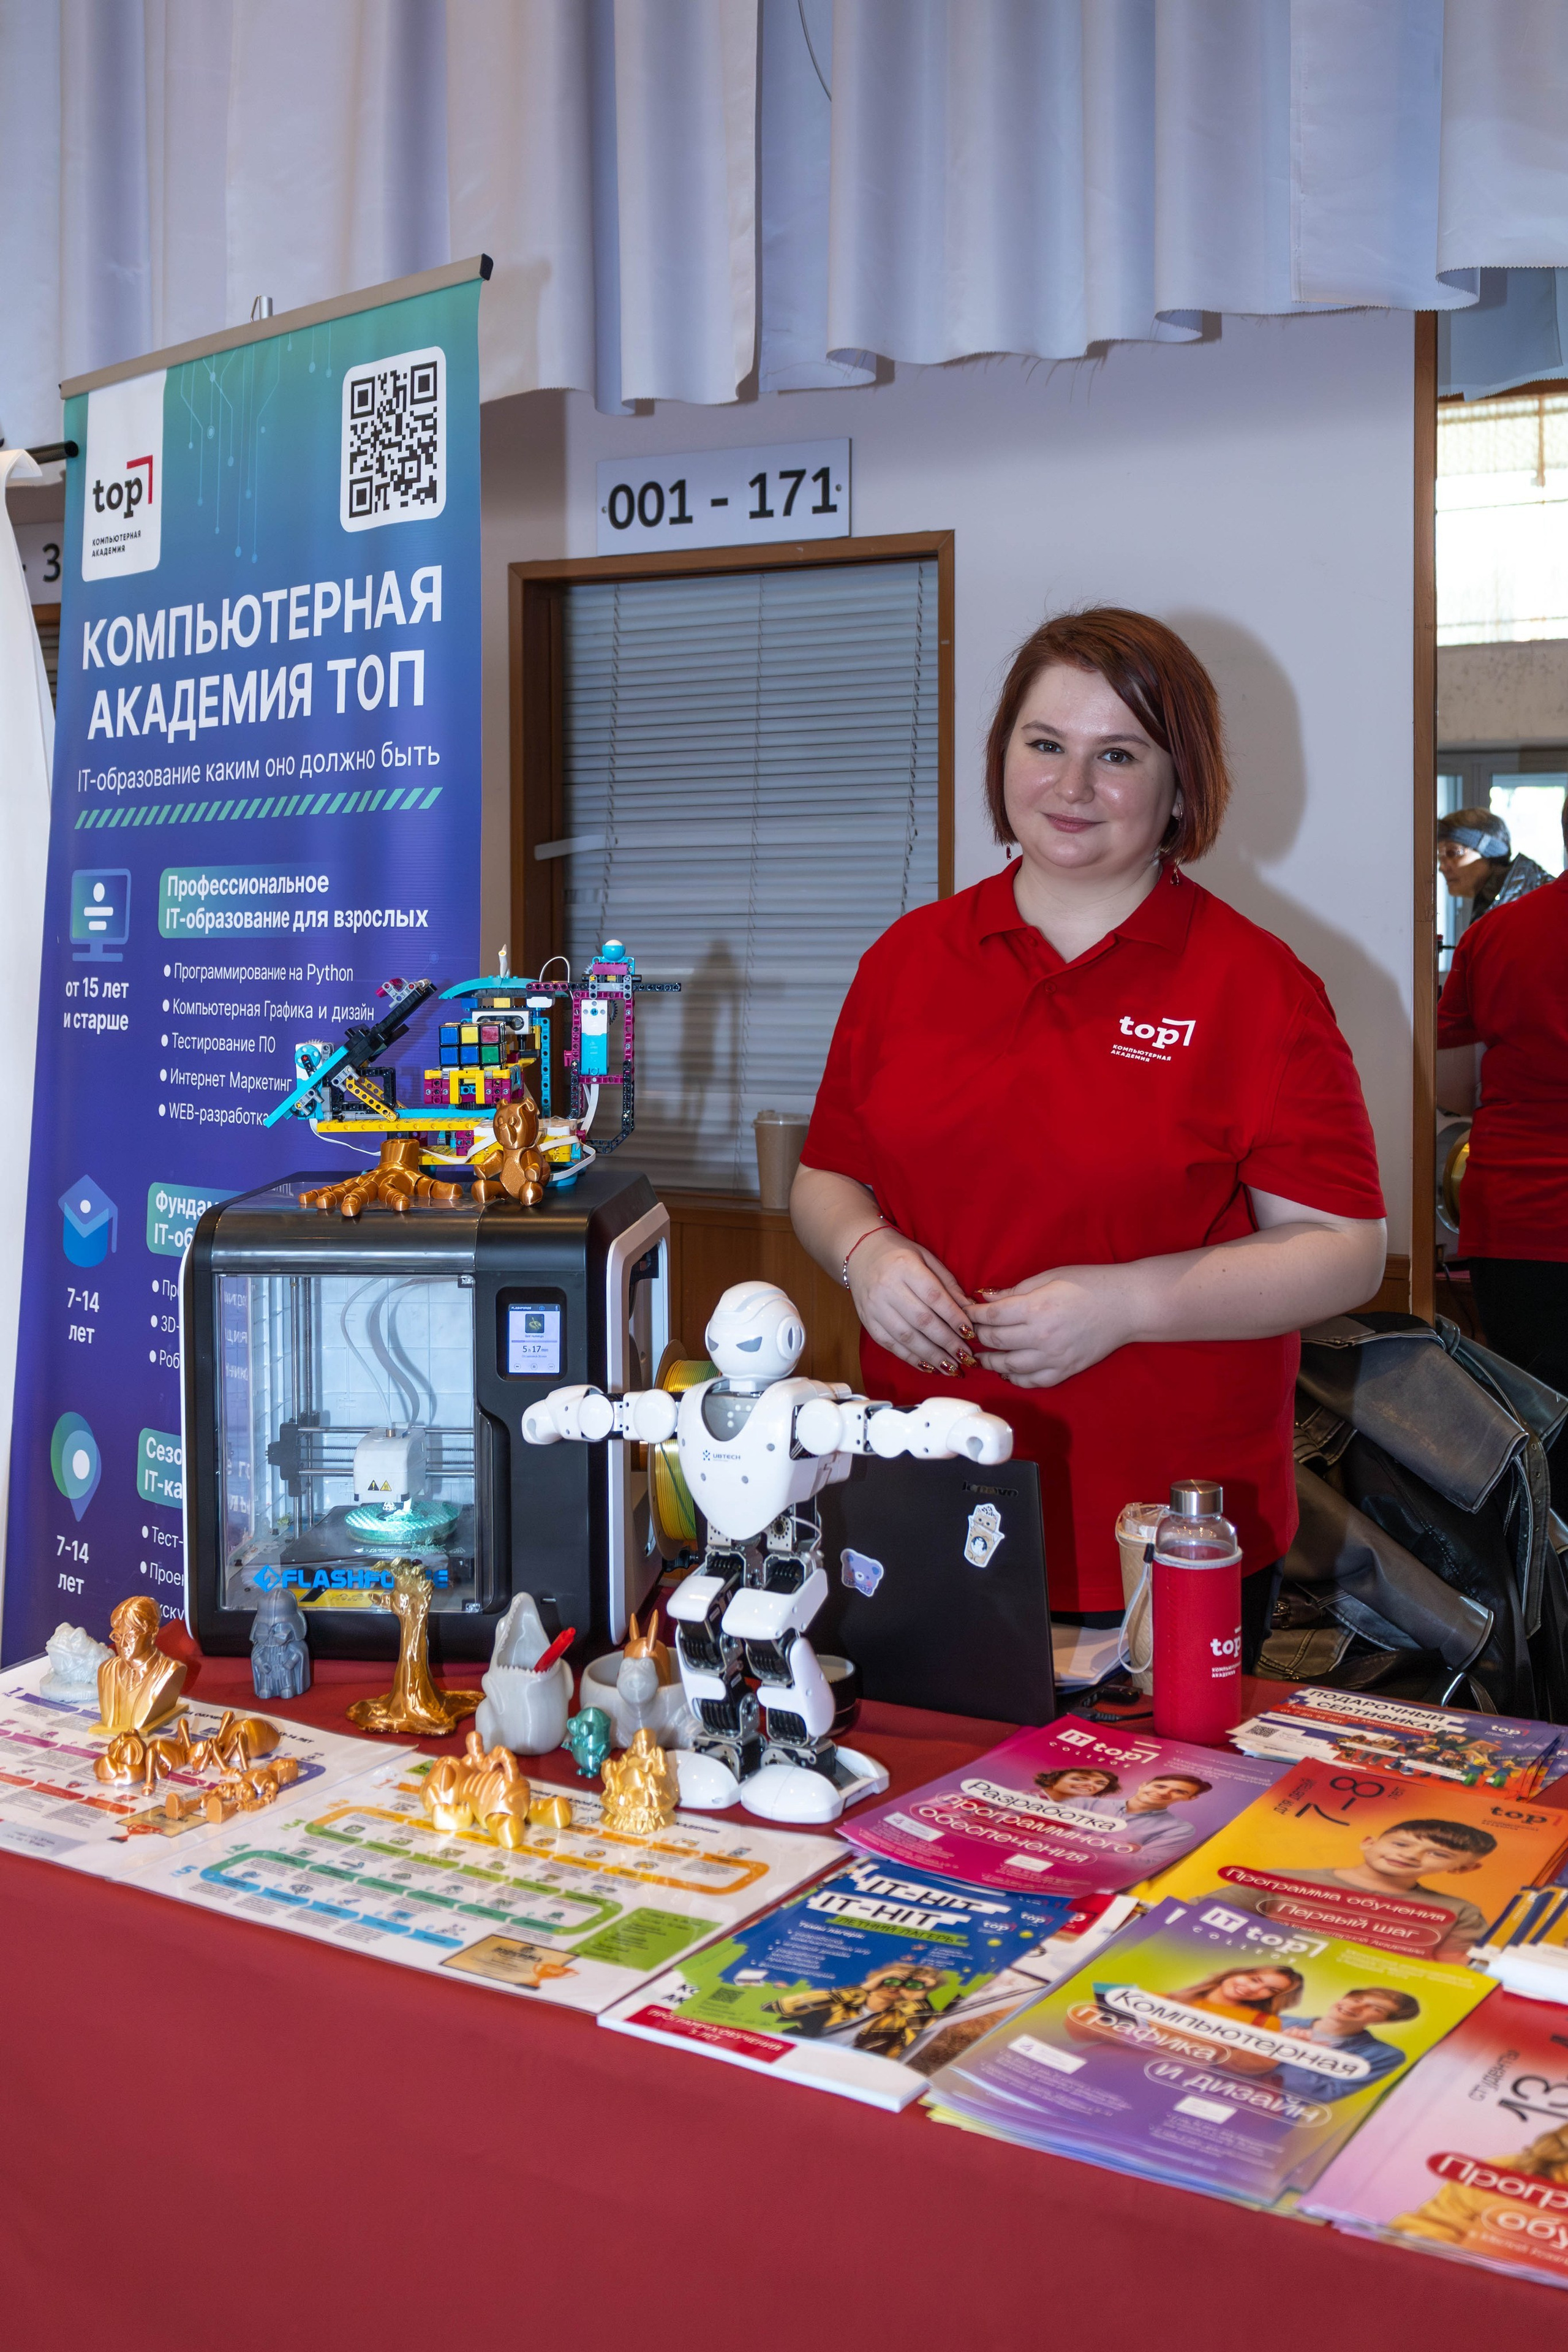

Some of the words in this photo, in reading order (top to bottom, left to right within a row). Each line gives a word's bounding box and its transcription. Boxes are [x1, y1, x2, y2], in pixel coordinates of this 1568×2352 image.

[92, 477, 143, 519] top
[608, 479, 693, 530] 001
[710, 497, 728, 507] -
[748, 467, 837, 519] 171
[92, 530, 141, 546] КОМПЬЮТЕРНАЯ
[91, 545, 126, 557] АКАДЕМИЯ
[82, 565, 443, 669] КОМПЬЮТЕРНАЯ
[87, 662, 313, 743] АКАДЕМИЯ
[327, 650, 425, 714] ТОП
[78, 762, 201, 795] IT-образование
[206, 759, 260, 783] каким
[265, 755, 295, 777] оно
[300, 745, 375, 777] должно
[380, 741, 440, 767] быть
[167, 872, 330, 902] Профессиональное
[166, 907, 290, 933] IT-образование
[293, 908, 326, 932] для
[334, 907, 429, 933] взрослых
[174, 962, 286, 985] Программирование
[288, 966, 303, 980] на
[307, 963, 354, 987] Python
[66, 981, 80, 998] от
[82, 978, 99, 998] 15
[102, 981, 129, 1000] лет
[172, 998, 260, 1021] Компьютерная
[264, 1000, 313, 1022] Графика
[318, 1005, 327, 1019] и
[331, 1004, 374, 1022] дизайн
[63, 1014, 71, 1027] и
[73, 1014, 129, 1034] старше
[1119, 1016, 1180, 1049] top
[172, 1033, 256, 1055] Тестирование
[259, 1036, 276, 1054] ПО
[1110, 1049, 1150, 1063] АКАДЕМИЯ
[1112, 1044, 1172, 1061] КОМПЬЮТЕРНАЯ
[170, 1068, 226, 1090] Интернет
[230, 1071, 293, 1093] Маркетинг
[169, 1102, 269, 1127] WEB-разработка
[67, 1288, 100, 1313] 7-14
[69, 1323, 95, 1344] лет
[56, 1536, 89, 1564] 7-14
[58, 1574, 85, 1594] лет
[1210, 1635, 1241, 1659] top
[1309, 1690, 1446, 1722] ПОДАРОЧНЫЙ
[1316, 1702, 1442, 1731] СЕРТИФИКАТ
[1065, 1733, 1090, 1743] IT
[1491, 1725, 1521, 1735] top
[1093, 1742, 1142, 1762] top
[968, 1781, 1117, 1831] Разработка
[1491, 1806, 1547, 1825] top
[918, 1806, 1089, 1863] обеспечения
[1226, 1867, 1341, 1902] Программа
[1346, 1896, 1447, 1922] обучения
[819, 1896, 941, 1926] IT-HIT
[1021, 1911, 1046, 1924] top
[1209, 1912, 1242, 1929] IT
[1276, 1903, 1369, 1929] Первый
[1372, 1923, 1420, 1939] шаг
[837, 1916, 896, 1936] ЛЕТНИЙ
[897, 1925, 957, 1943] ЛАГЕРЬ
[983, 1920, 1009, 1931] top
[1245, 1925, 1310, 1954] top
[646, 2009, 717, 2033] ПРОГРАММА
[718, 2026, 784, 2051] ОБУЧЕНИЯ
[698, 2030, 722, 2041] ЛЕТ
[1076, 2007, 1217, 2060] Графика
[1114, 1990, 1359, 2077] Компьютерная
[1182, 2075, 1321, 2124] дизайн
